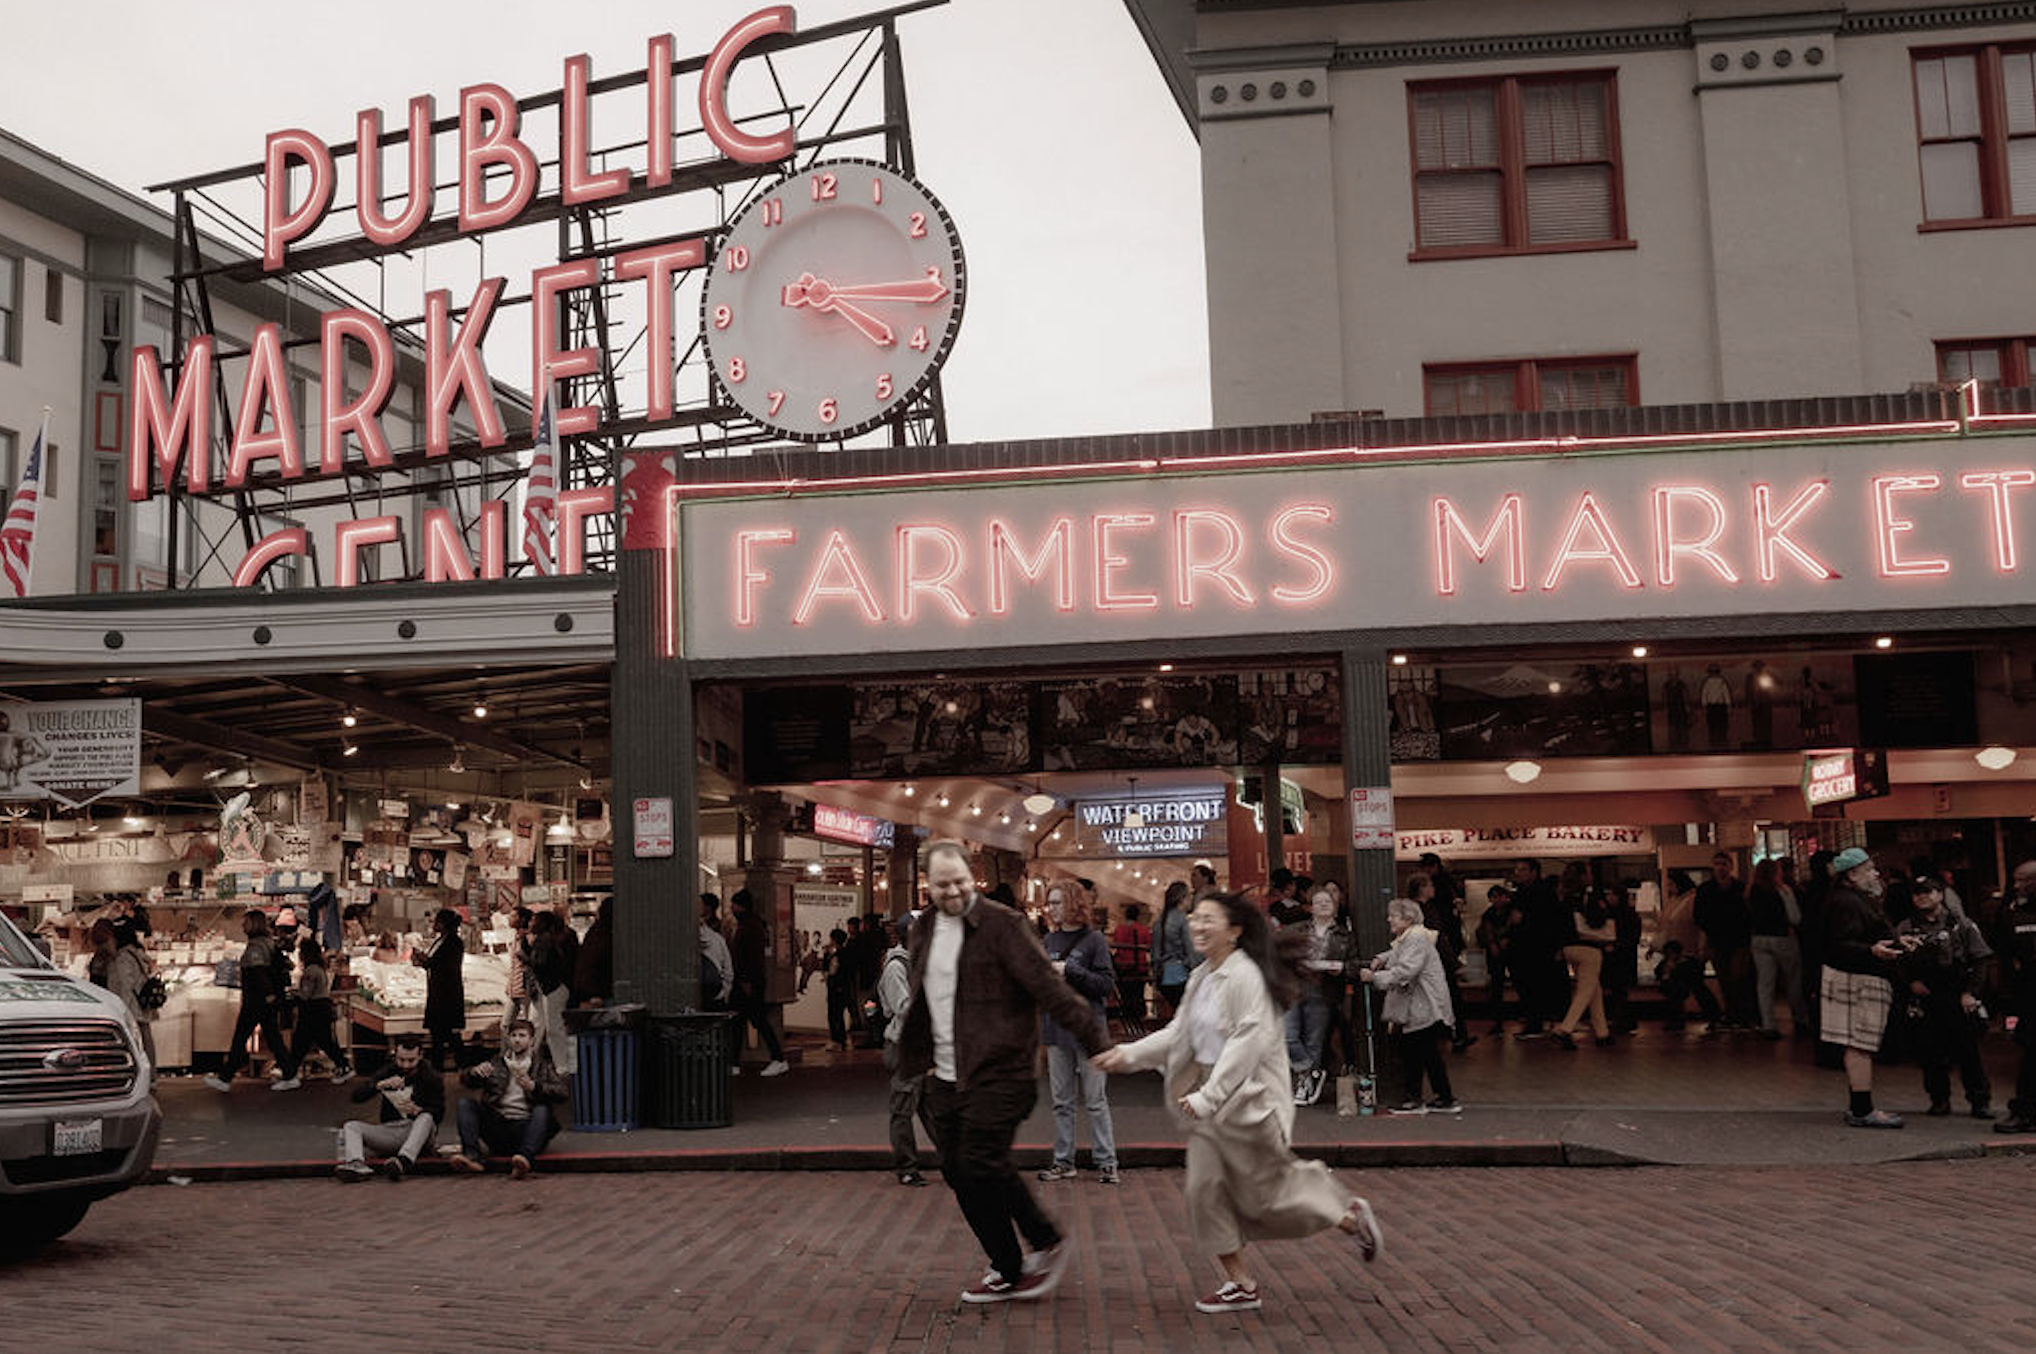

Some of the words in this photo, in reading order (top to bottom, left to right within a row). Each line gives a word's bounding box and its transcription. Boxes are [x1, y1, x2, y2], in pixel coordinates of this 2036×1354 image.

[263, 5, 796, 271] PUBLIC
[811, 173, 837, 201] 12
[873, 178, 882, 205] 1
[762, 199, 782, 226] 11
[909, 211, 927, 238] 2
[727, 247, 748, 273] 10
[714, 304, 733, 330] 9
[909, 326, 930, 351] 4
[128, 238, 705, 500] MARKET
[728, 357, 746, 383] 8
[875, 374, 893, 400] 5
[767, 391, 785, 417] 7
[818, 398, 838, 424] 6
[734, 506, 1334, 626] FARMERS
[1433, 470, 2036, 595] MARKET
[1102, 824, 1206, 844] VIEWPOINT
[1399, 832, 1454, 850] PIKE
[1462, 827, 1536, 843] PLACE
[1546, 826, 1645, 844] BAKERY
